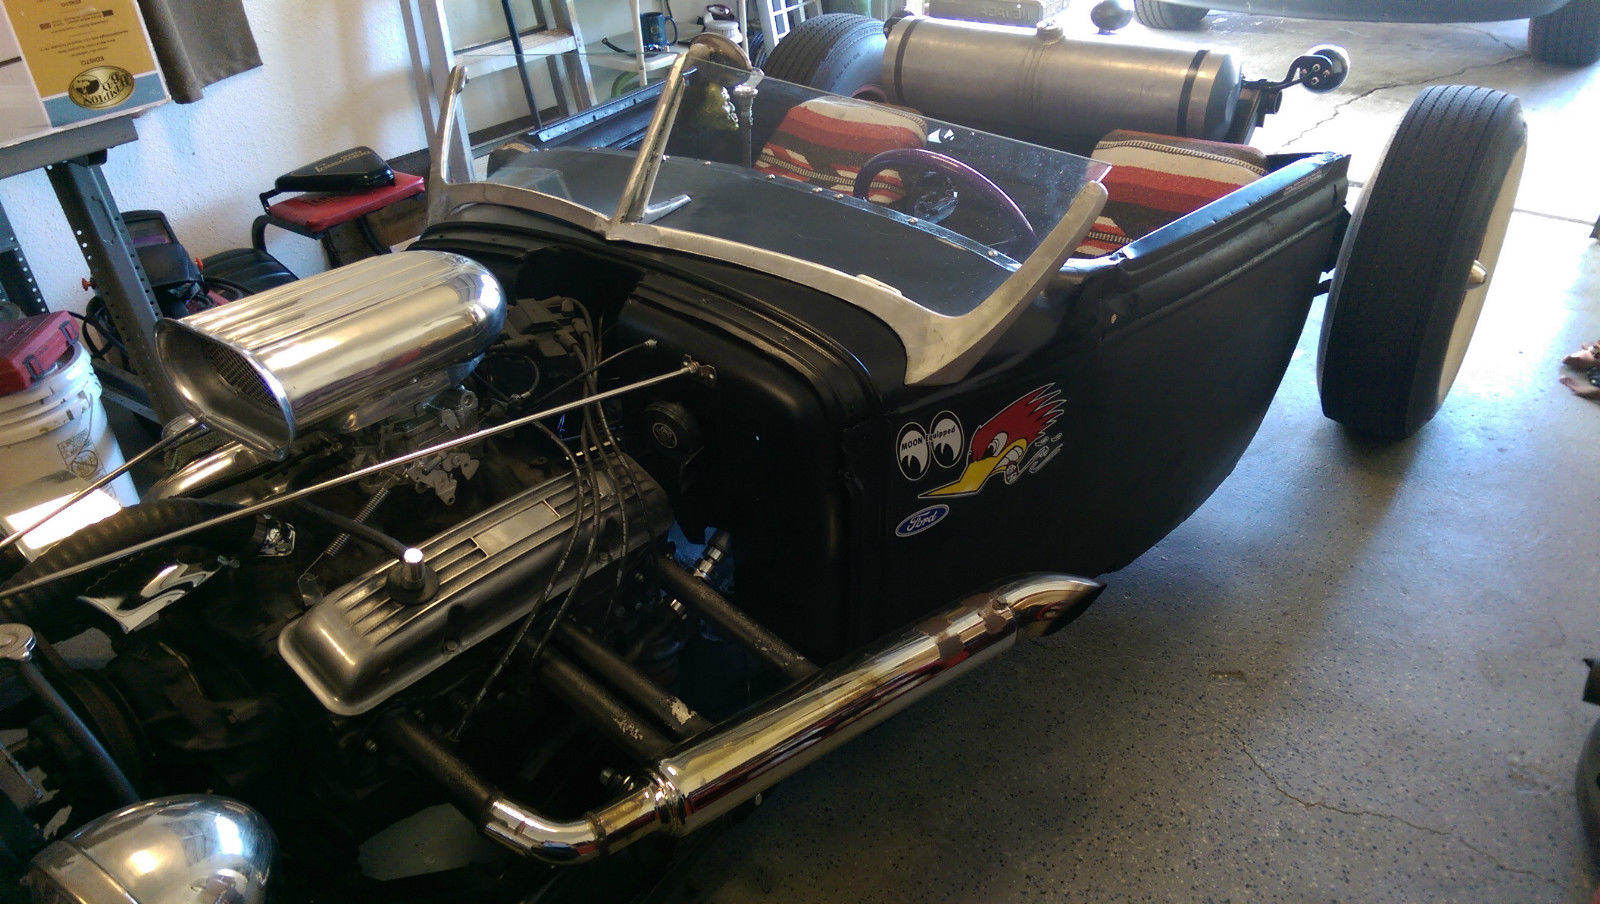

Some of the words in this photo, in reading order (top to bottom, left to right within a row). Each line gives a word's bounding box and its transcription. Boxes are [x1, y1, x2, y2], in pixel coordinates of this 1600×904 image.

[901, 437, 923, 451] MOON
[926, 426, 956, 441] Equipped
[906, 510, 938, 531] Ford
